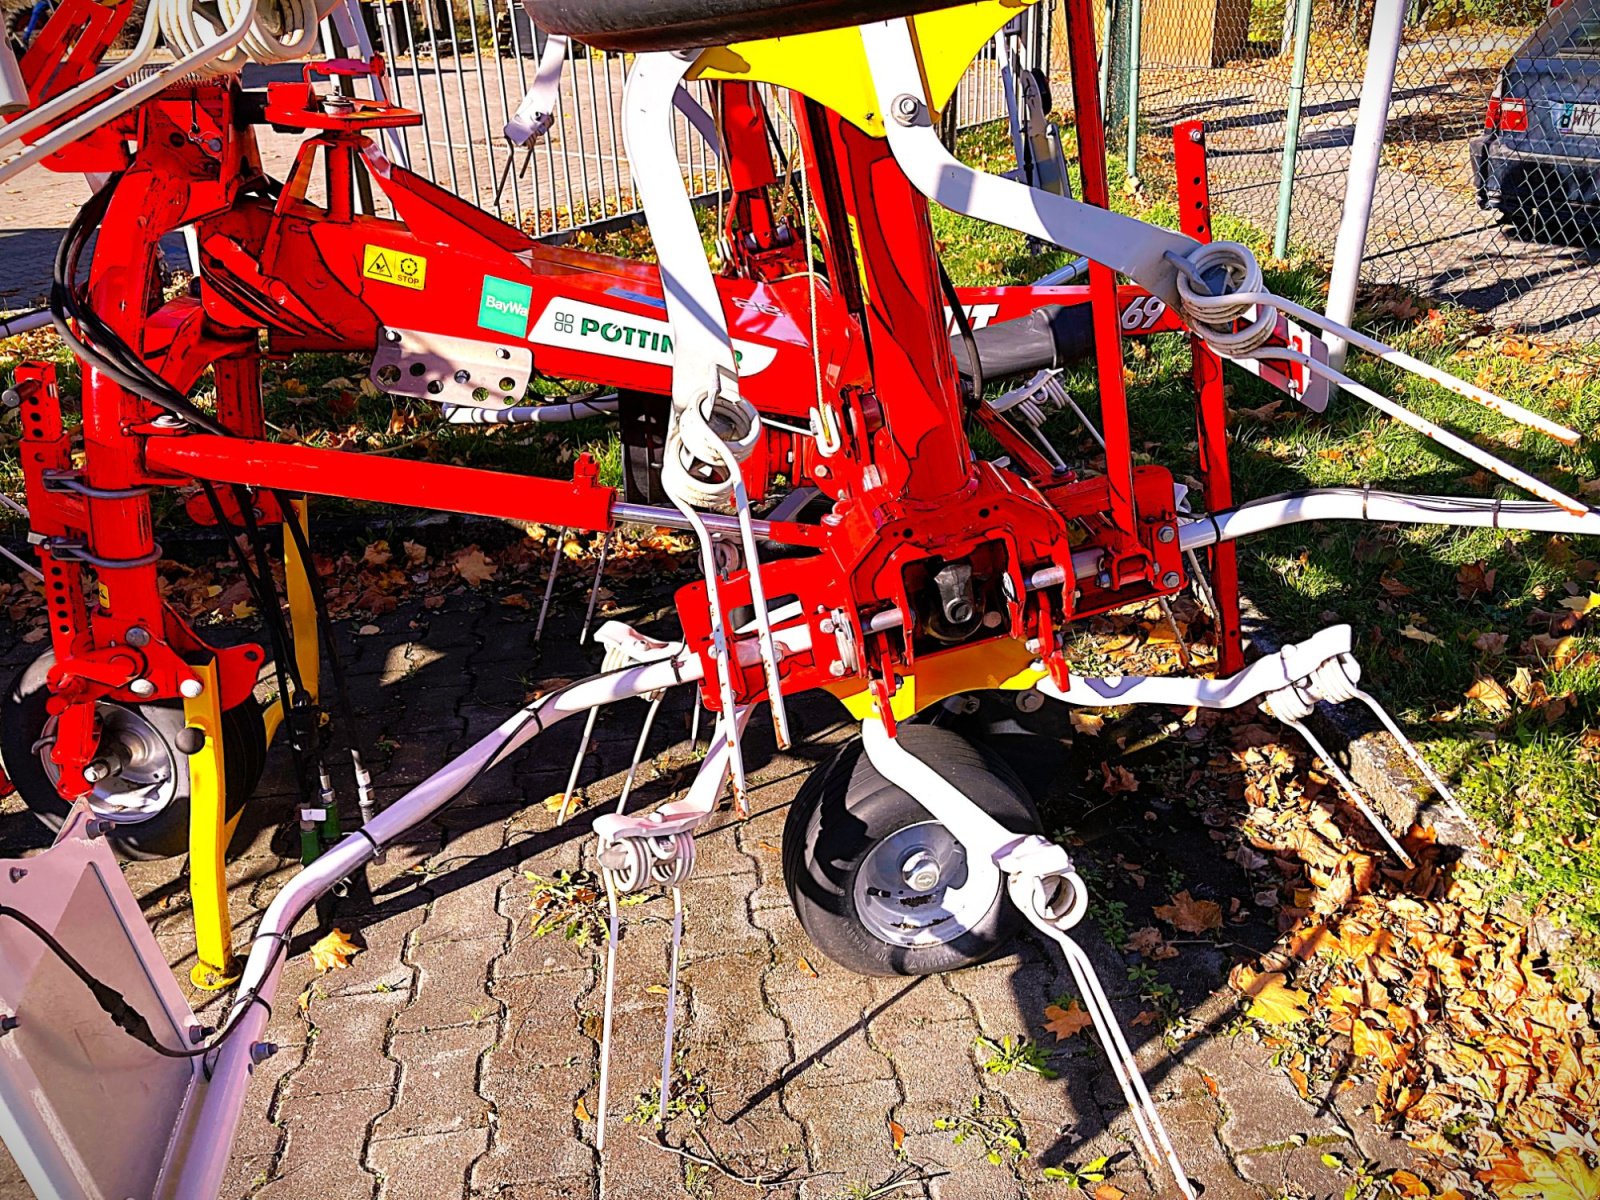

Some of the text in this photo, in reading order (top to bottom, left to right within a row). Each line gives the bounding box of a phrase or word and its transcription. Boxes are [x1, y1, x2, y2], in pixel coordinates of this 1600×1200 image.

[397, 274, 420, 285] STOP
[485, 294, 529, 317] BayWa
[1121, 296, 1166, 330] 69
